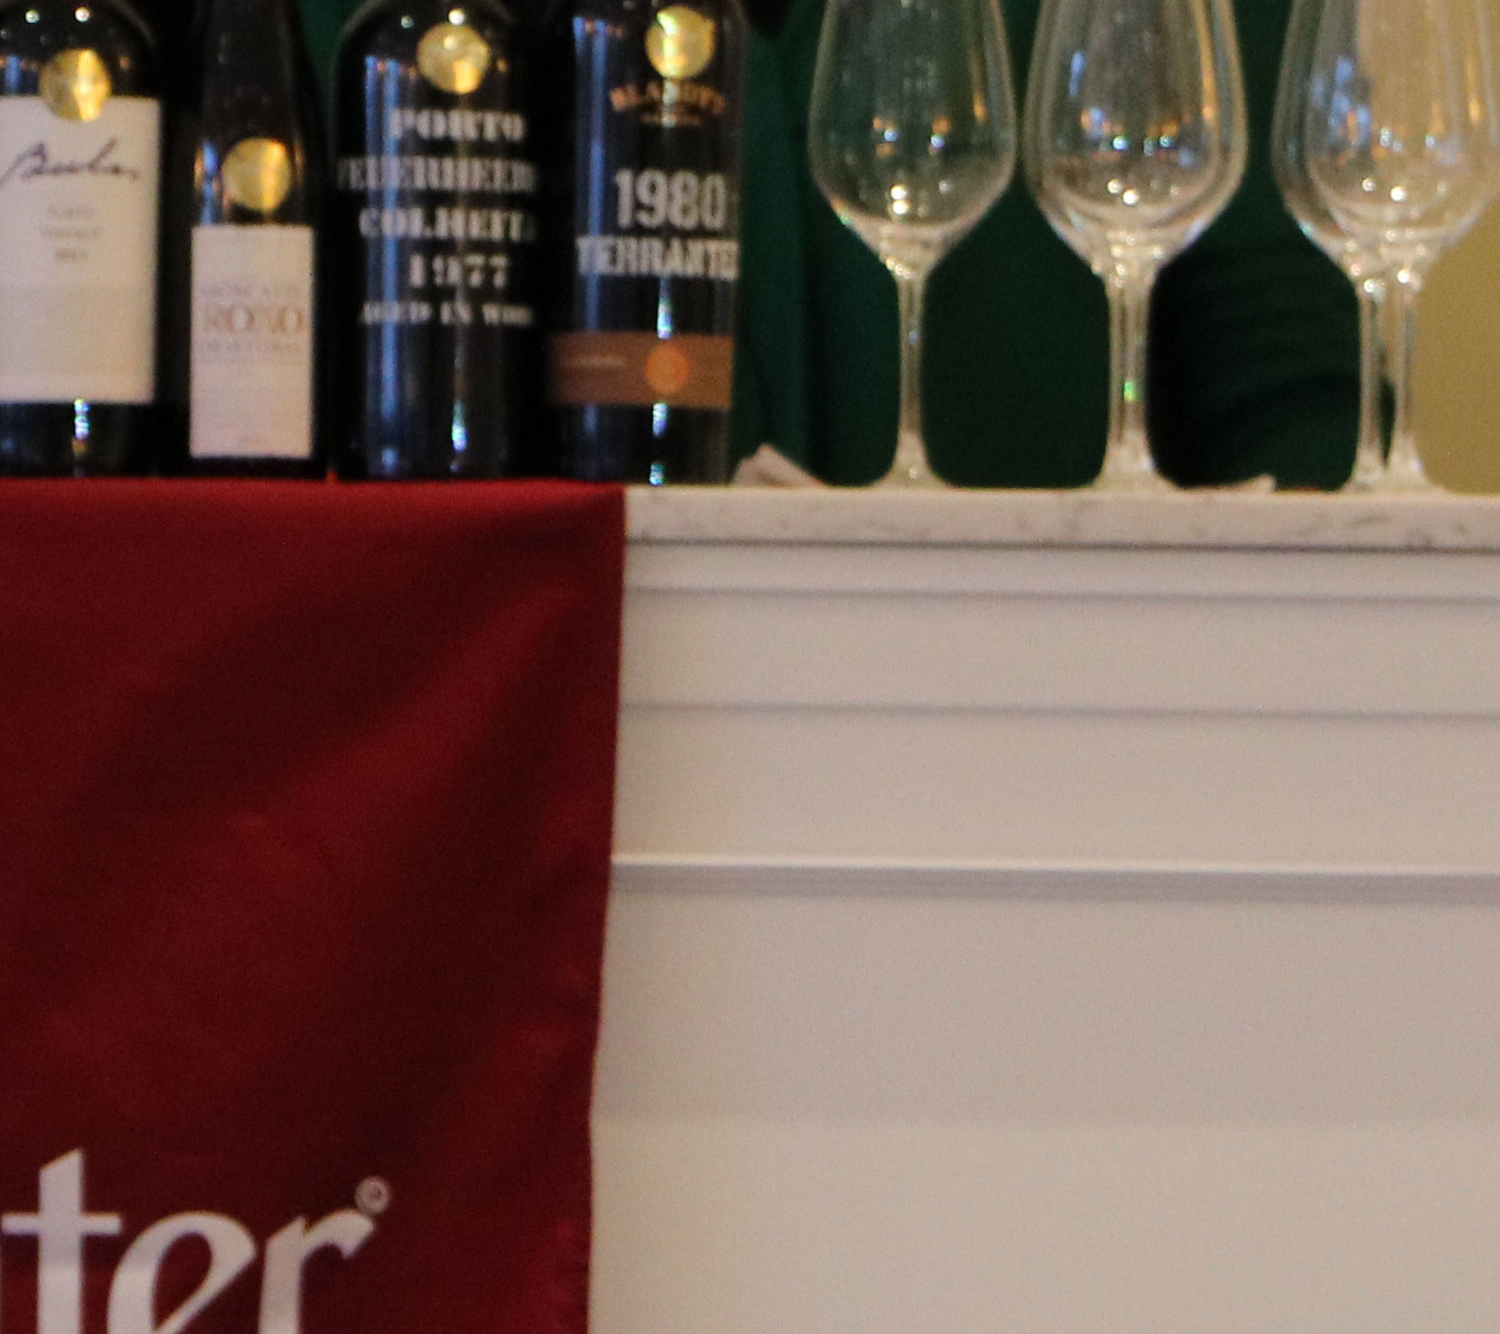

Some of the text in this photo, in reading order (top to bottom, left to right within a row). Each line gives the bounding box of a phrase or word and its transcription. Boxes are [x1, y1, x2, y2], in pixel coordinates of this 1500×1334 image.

[390, 108, 527, 142] PORTO
[615, 168, 728, 231] 1980
[409, 254, 508, 289] 1977
